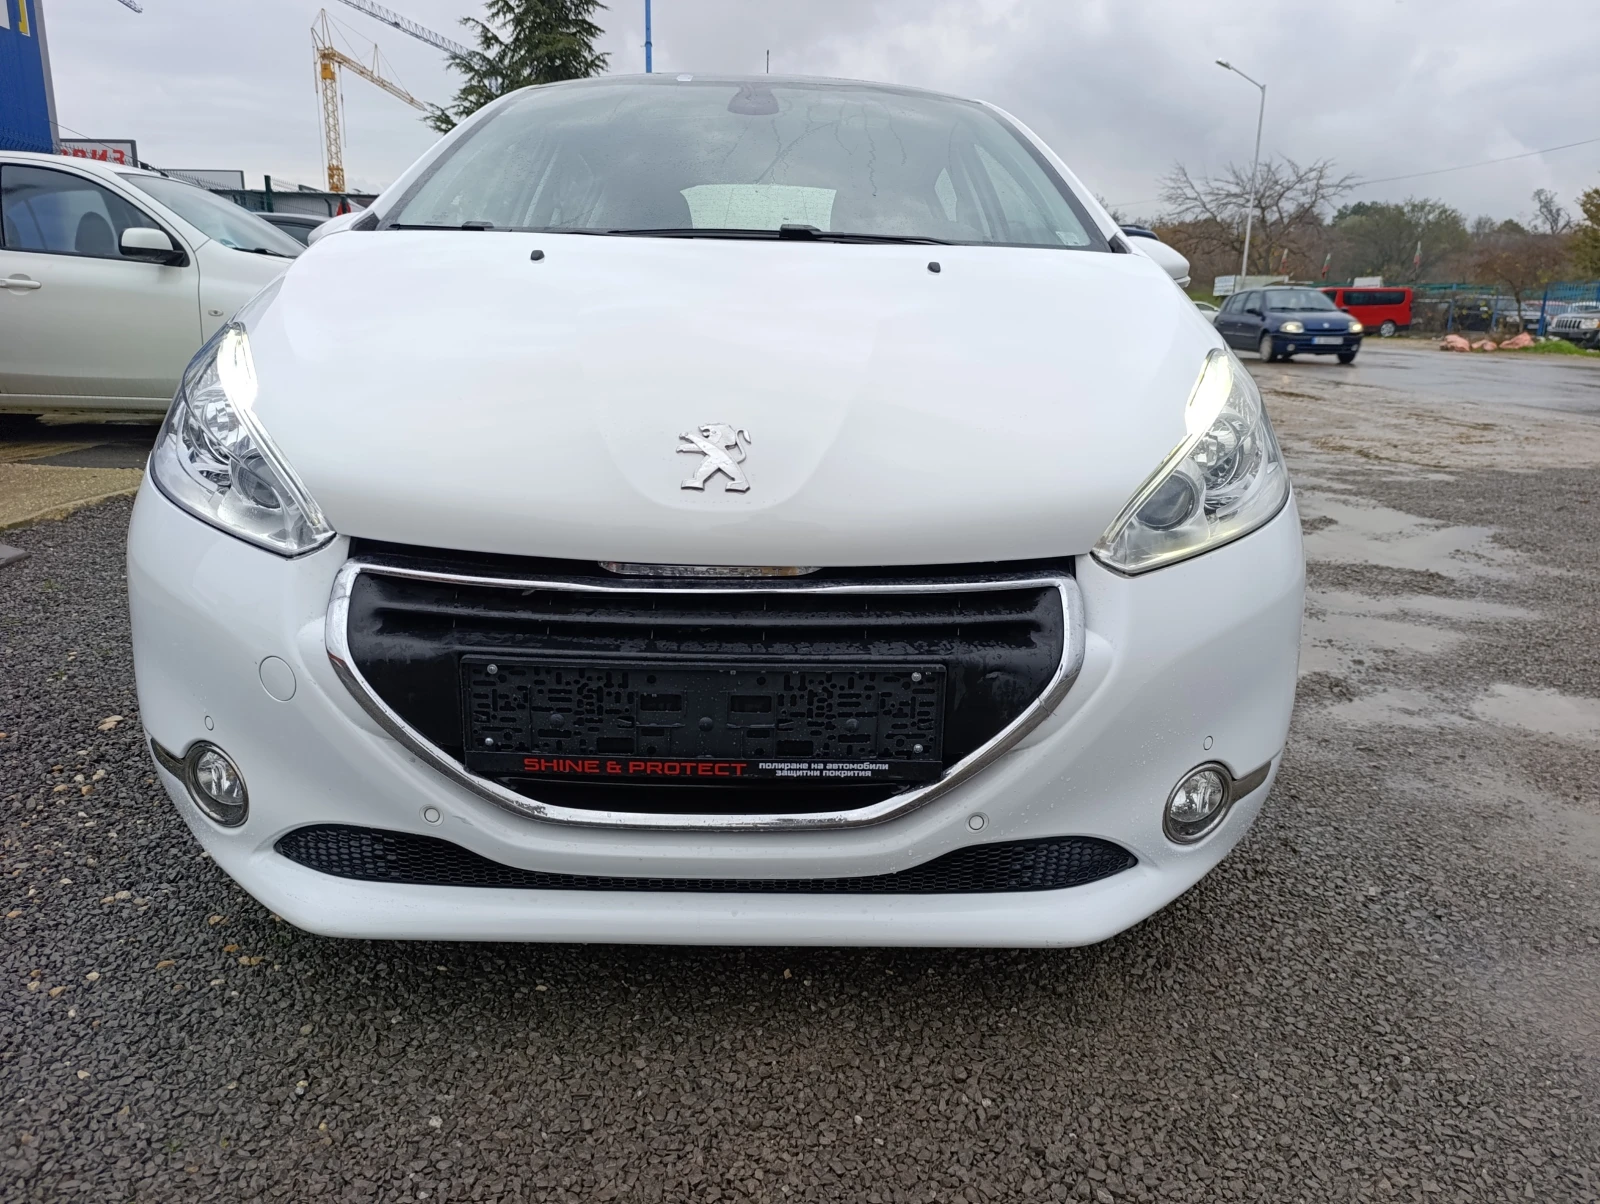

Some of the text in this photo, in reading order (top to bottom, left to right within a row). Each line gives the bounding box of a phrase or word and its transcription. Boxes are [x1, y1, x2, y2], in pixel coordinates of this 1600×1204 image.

[524, 758, 747, 775] SHINE & PROTECT
[759, 762, 808, 771] полиране
[826, 762, 888, 770] автомобили
[776, 769, 820, 777] защитни
